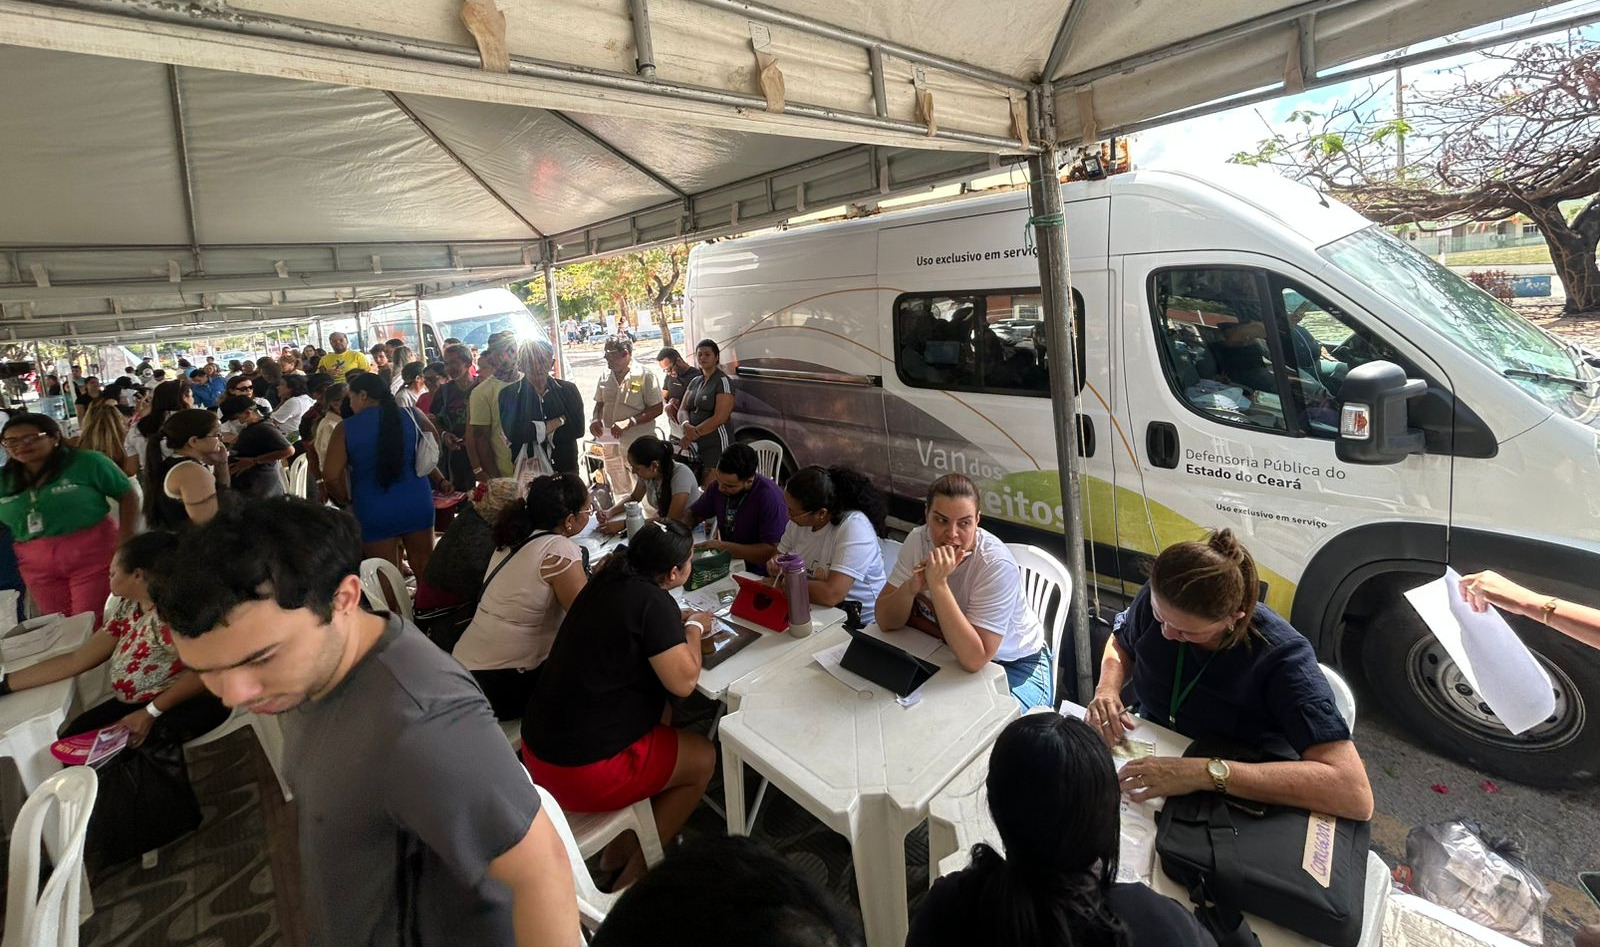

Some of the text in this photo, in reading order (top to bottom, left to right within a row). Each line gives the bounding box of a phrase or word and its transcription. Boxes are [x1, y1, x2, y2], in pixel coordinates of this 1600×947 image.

[916, 244, 1038, 267] Uso exclusivo em serviç
[916, 438, 1002, 480] Van dos
[1185, 448, 1346, 480] Defensoria Pública do
[1186, 463, 1302, 490] Estado do Ceará
[1216, 503, 1328, 529] Uso exclusivo em serviço
